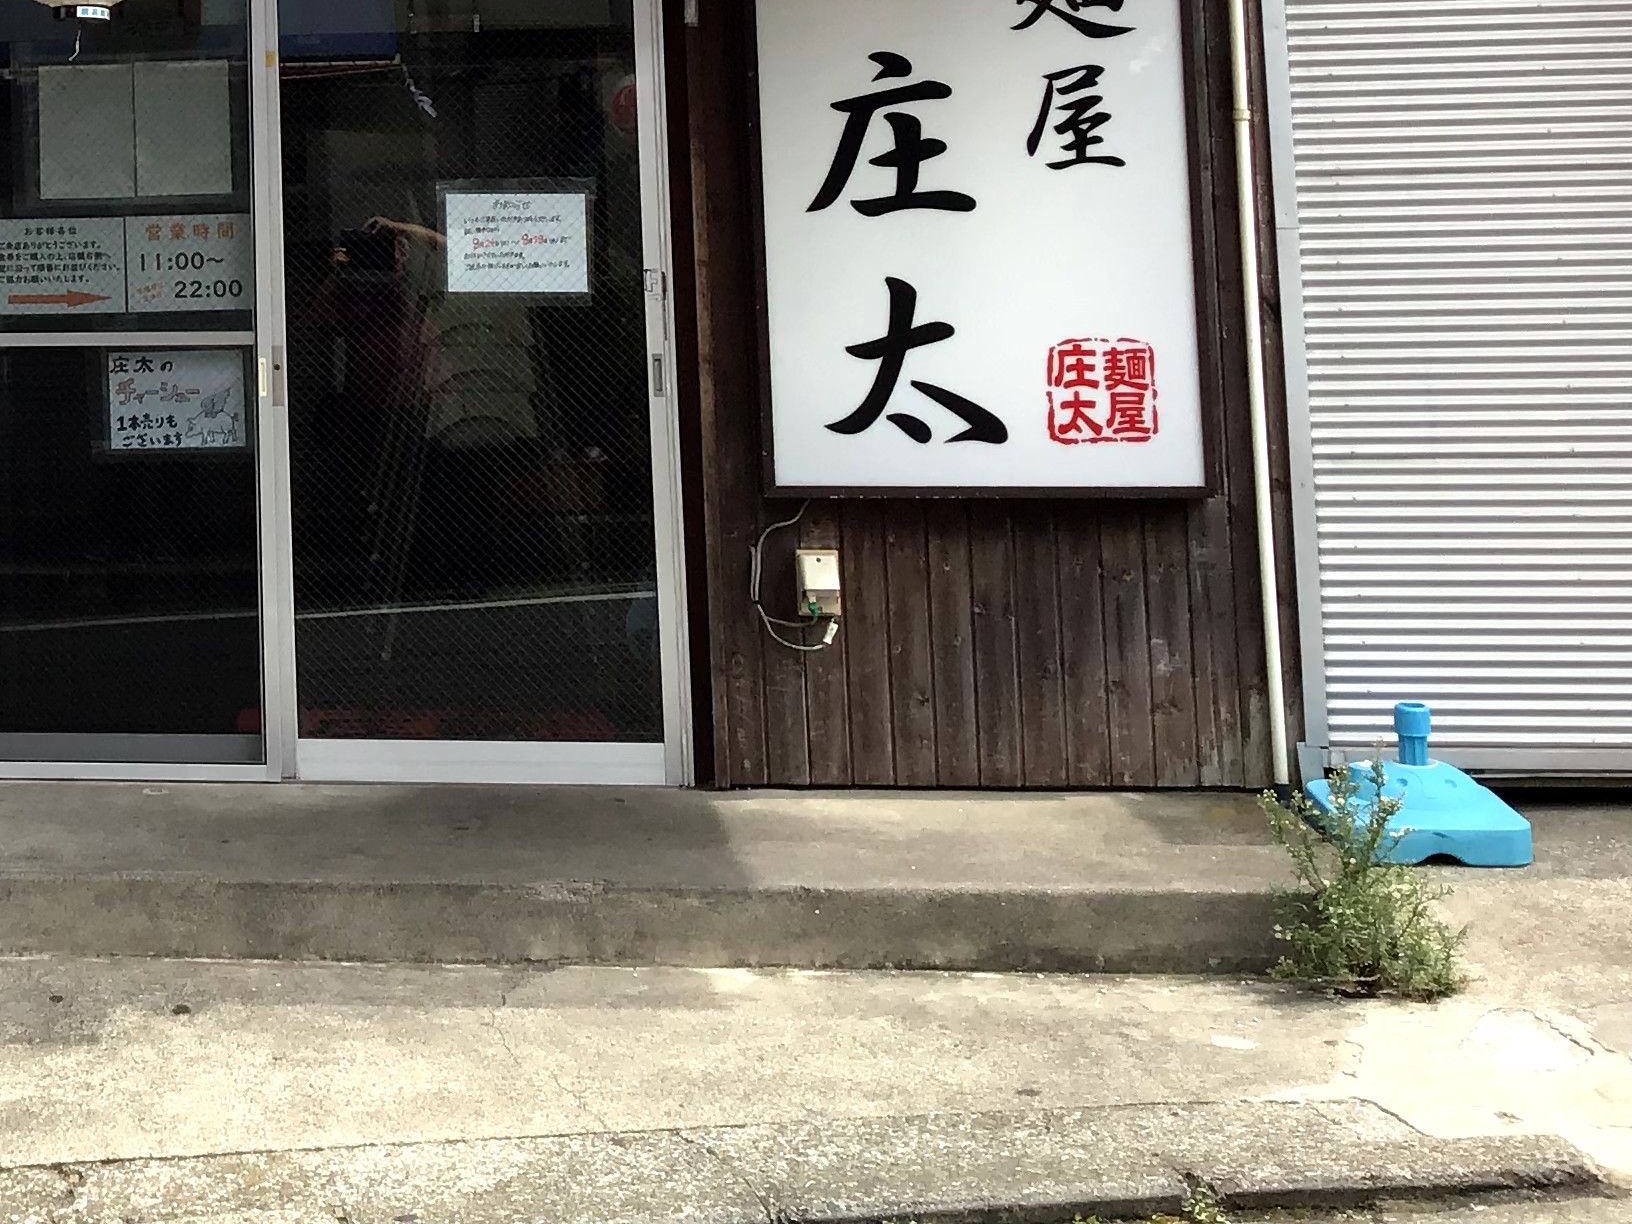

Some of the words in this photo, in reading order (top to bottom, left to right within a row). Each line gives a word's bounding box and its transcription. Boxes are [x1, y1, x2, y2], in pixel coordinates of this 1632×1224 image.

[145, 221, 235, 241] 営業時間
[805, 52, 1009, 445] 庄太
[174, 279, 243, 299] 22:00
[110, 355, 173, 374] 庄太の
[115, 377, 200, 406] チャーシュー
[116, 413, 178, 431] 1本売りも
[122, 432, 183, 447] ございます
